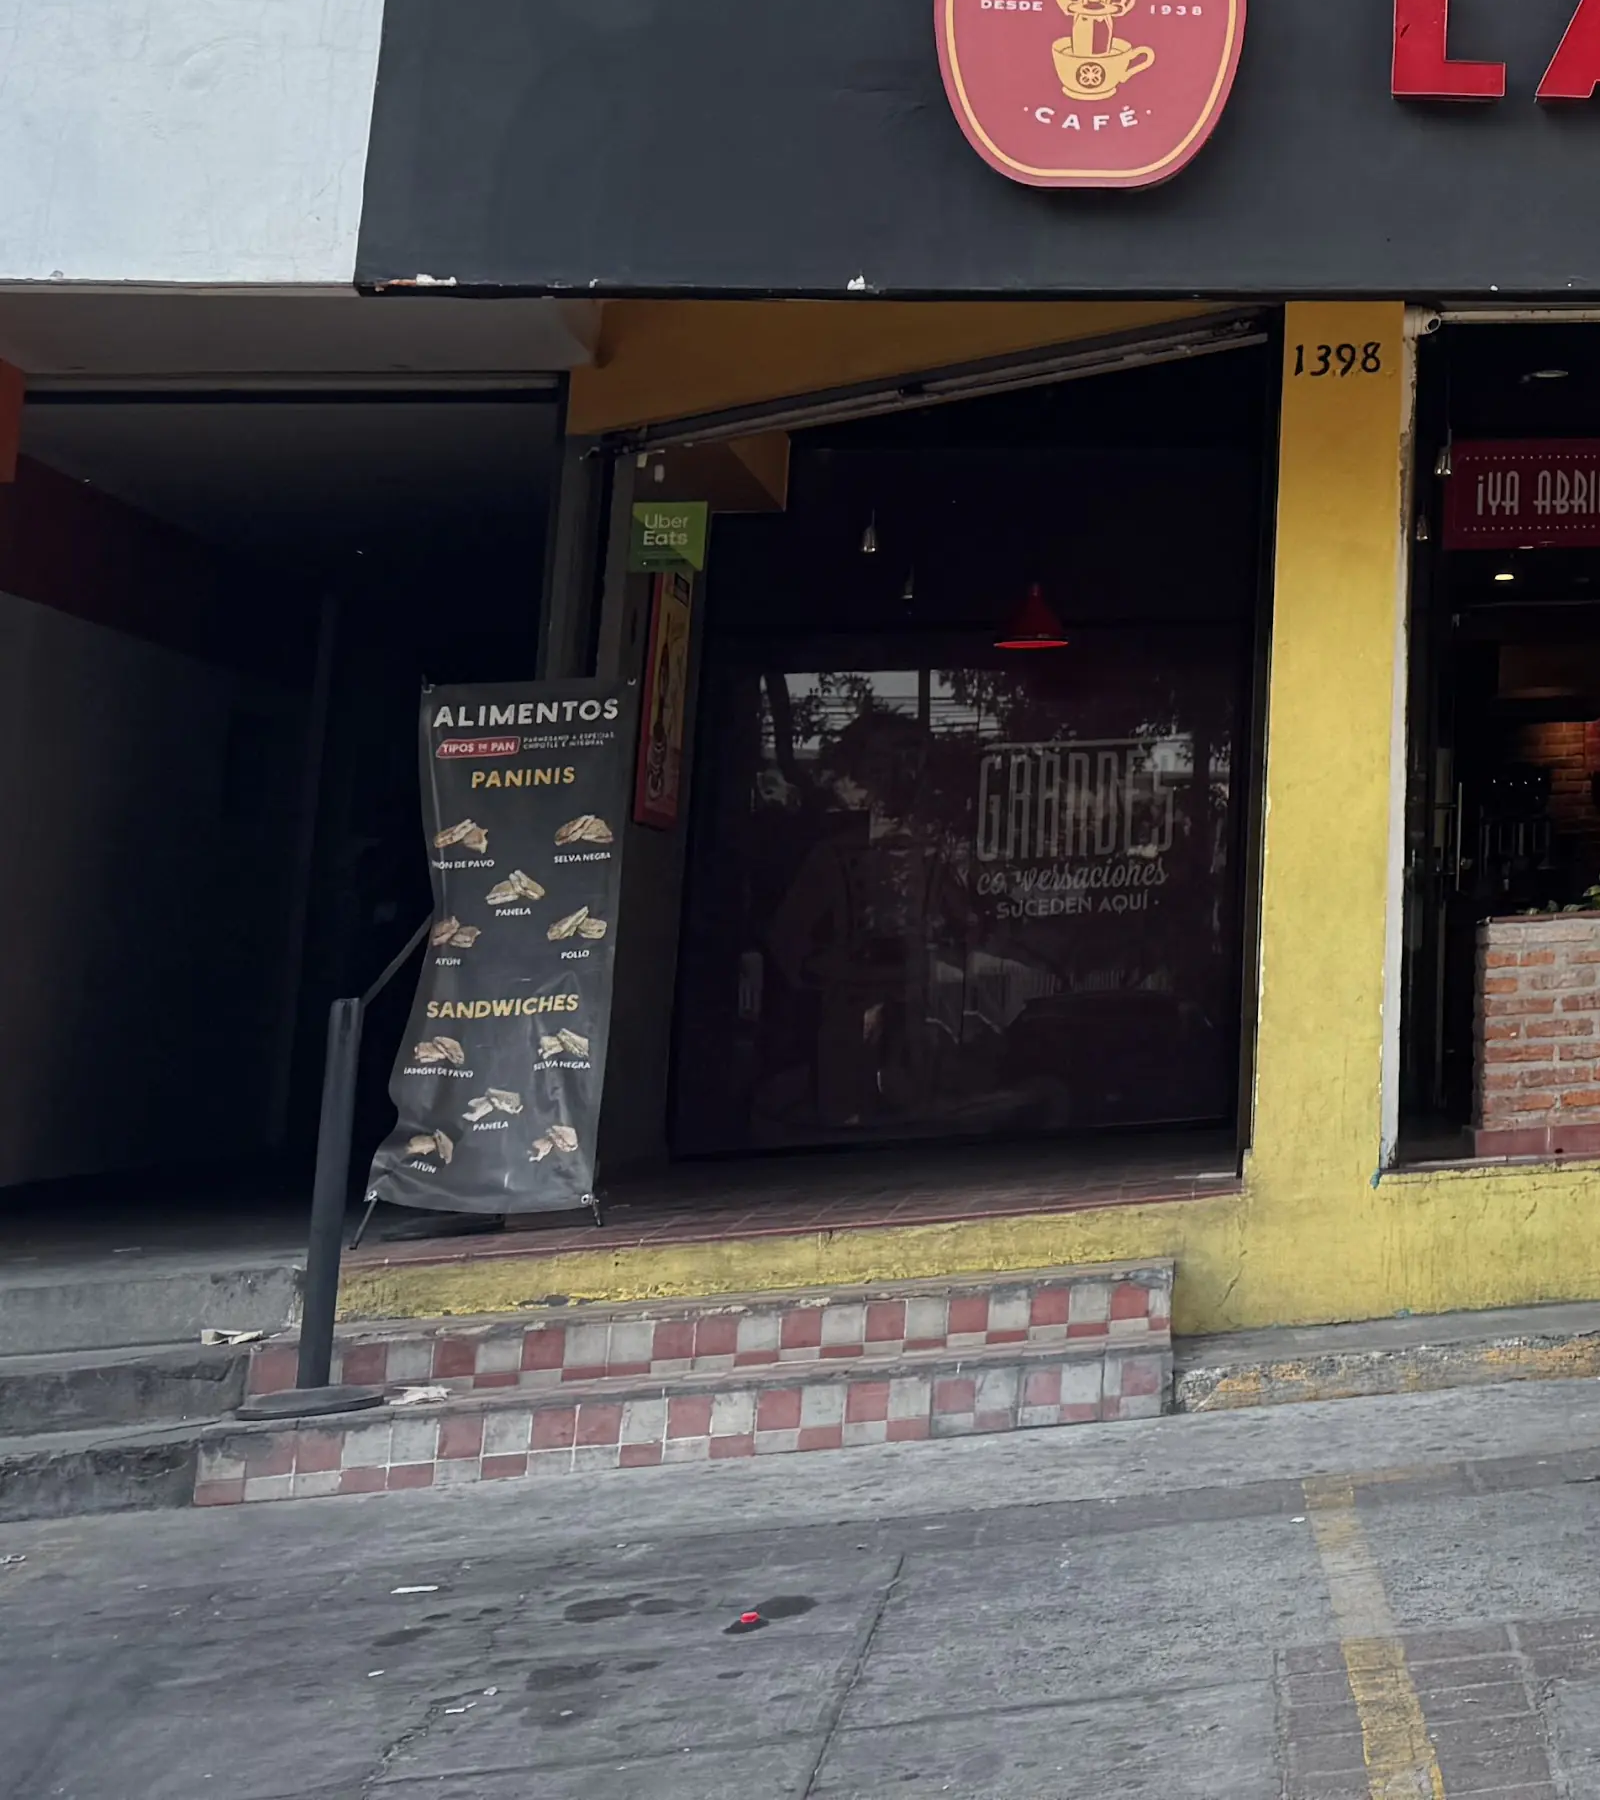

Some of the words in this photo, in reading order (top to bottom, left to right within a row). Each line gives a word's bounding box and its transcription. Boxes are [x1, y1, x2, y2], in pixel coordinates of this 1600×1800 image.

[1149, 4, 1203, 16] 1938
[1034, 105, 1139, 131] CAFÉ
[1293, 341, 1382, 378] 1398
[1476, 469, 1520, 516] ¡YA
[643, 512, 689, 530] Uber
[643, 529, 689, 547] Eats
[432, 698, 619, 728] ALIMENTOS
[442, 743, 475, 754] TIPOS
[490, 741, 516, 752] PAN
[471, 766, 576, 789] PANINIS
[976, 751, 1174, 862] GRANDES
[454, 860, 467, 869] DE
[467, 859, 495, 869] PAVO
[554, 854, 583, 864] SELVA
[584, 852, 611, 862] NEGRA
[495, 907, 532, 917] PANELA
[996, 896, 1093, 920] SUCEDEN
[1098, 890, 1150, 915] AQUÍ
[435, 956, 461, 967] ATÚN
[561, 949, 590, 959] POLLO
[426, 994, 579, 1019] SANDWICHES
[472, 1120, 509, 1132] PANELA
